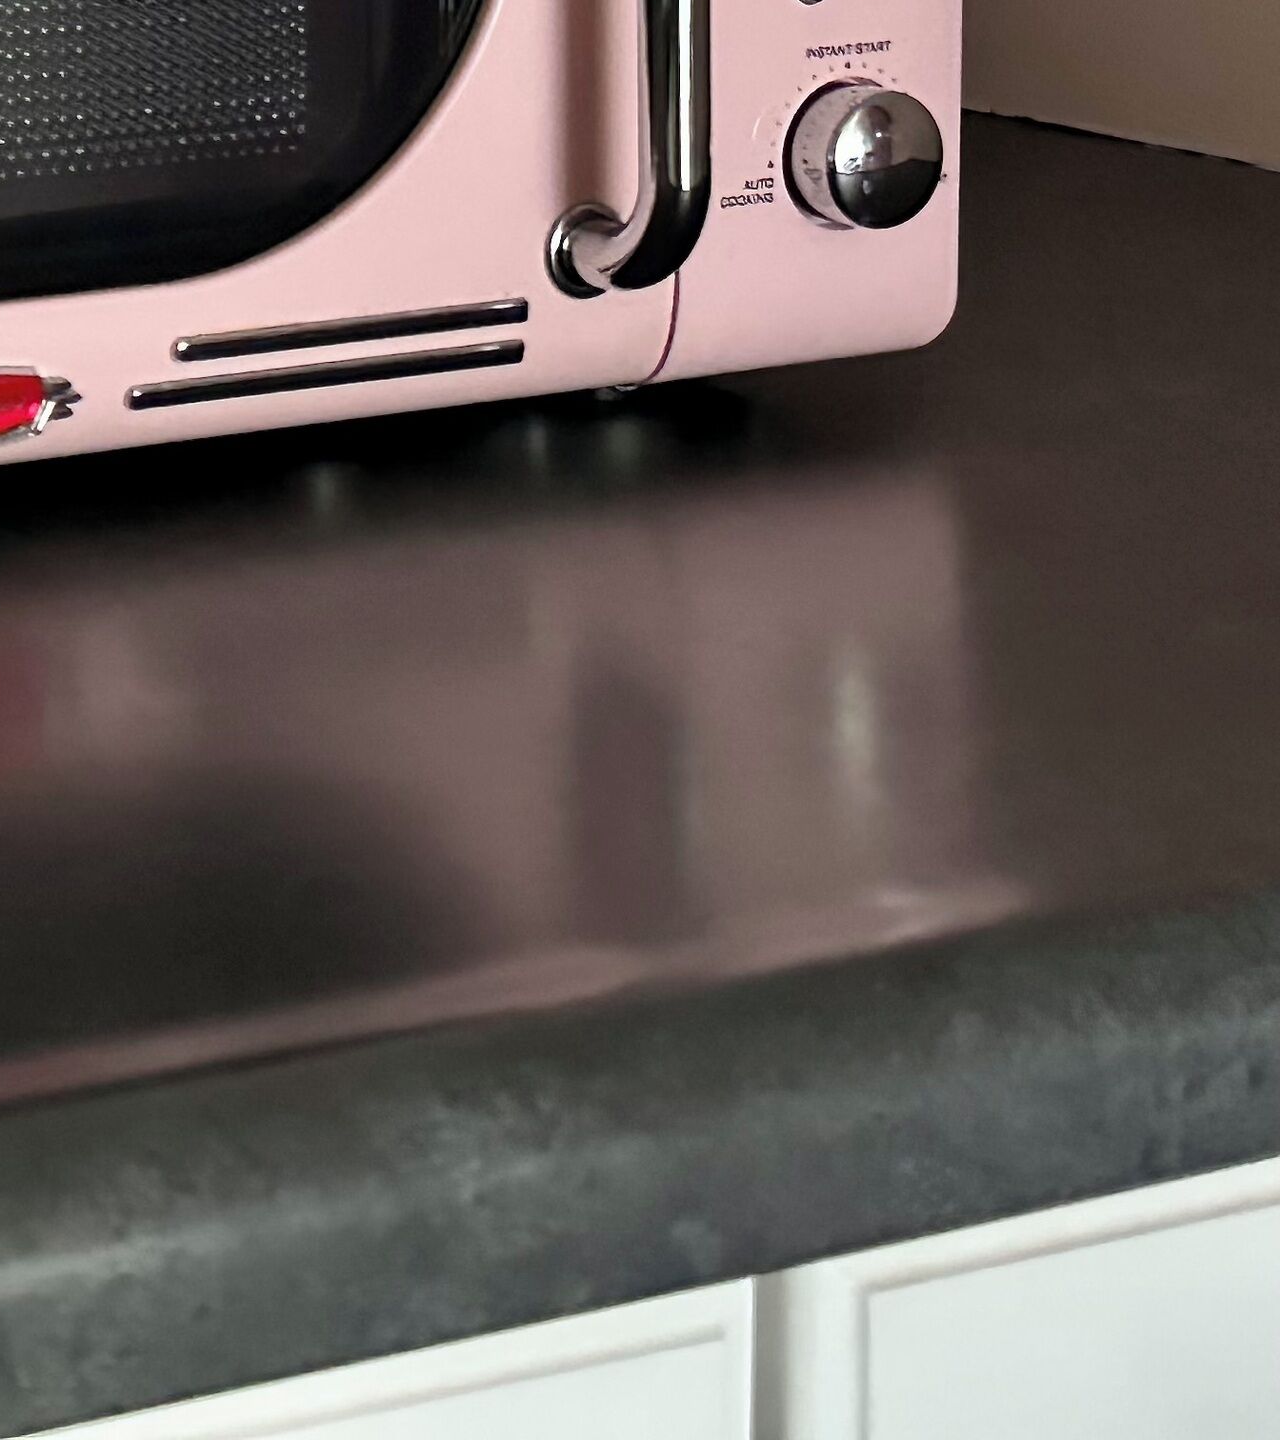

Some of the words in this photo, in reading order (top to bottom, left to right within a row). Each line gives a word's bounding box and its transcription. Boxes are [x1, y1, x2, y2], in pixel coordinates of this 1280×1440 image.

[805, 43, 852, 59] INSTANT
[855, 40, 892, 55] START
[742, 177, 775, 190] AUTO
[719, 192, 775, 209] COOKING
